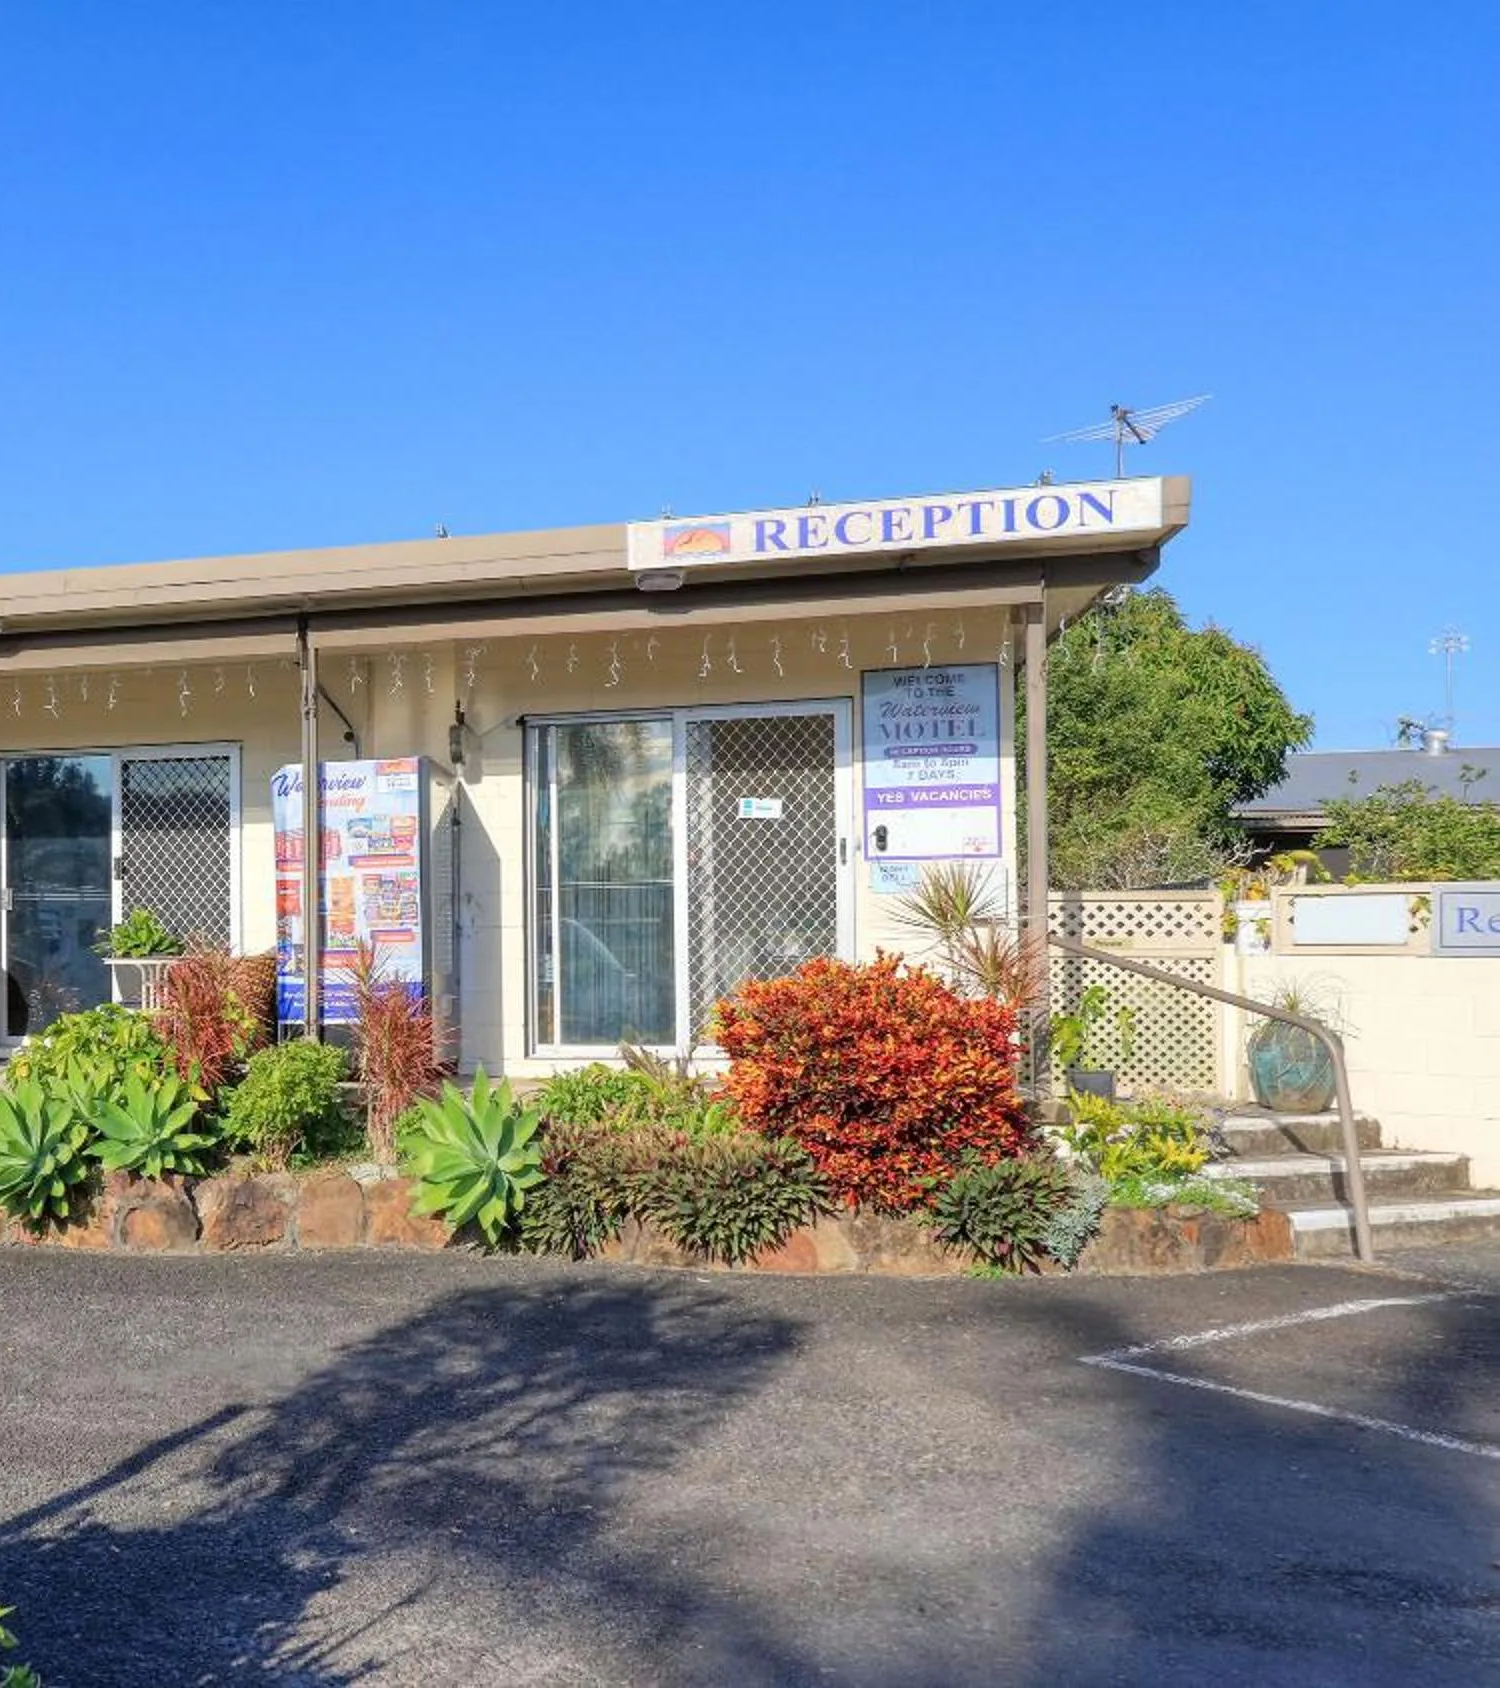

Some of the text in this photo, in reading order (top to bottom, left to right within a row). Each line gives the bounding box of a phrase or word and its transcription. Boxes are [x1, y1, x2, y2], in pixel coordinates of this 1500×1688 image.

[754, 489, 1118, 553] RECEPTION
[892, 673, 966, 688] WELCOME
[904, 685, 956, 699] TO THE
[880, 700, 981, 719] Waterview
[880, 718, 986, 741] MOTEL
[918, 769, 956, 781] DAYS
[877, 788, 993, 805] YES VACANCIES
